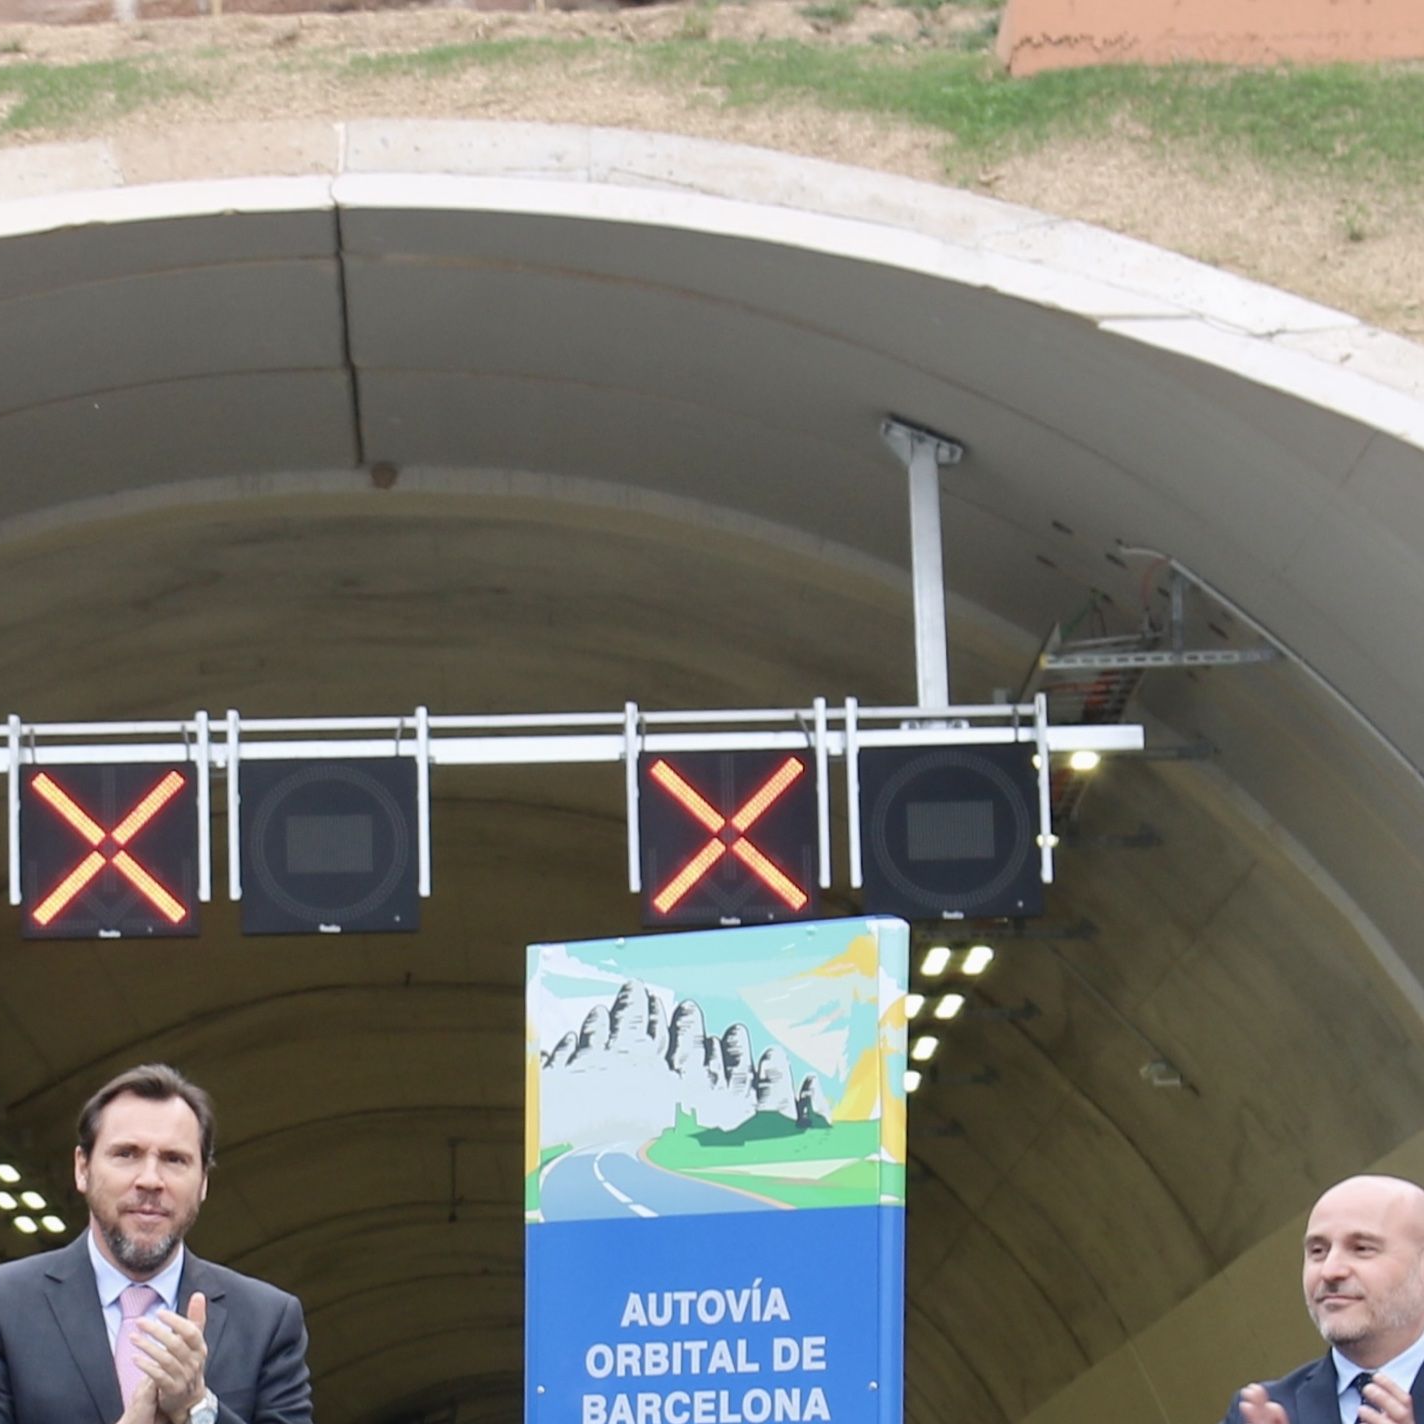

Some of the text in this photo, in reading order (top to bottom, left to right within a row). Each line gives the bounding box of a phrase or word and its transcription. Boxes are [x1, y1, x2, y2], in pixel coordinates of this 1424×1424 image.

[620, 1277, 790, 1327] AUTOVÍA
[585, 1336, 826, 1378] ORBITAL DE
